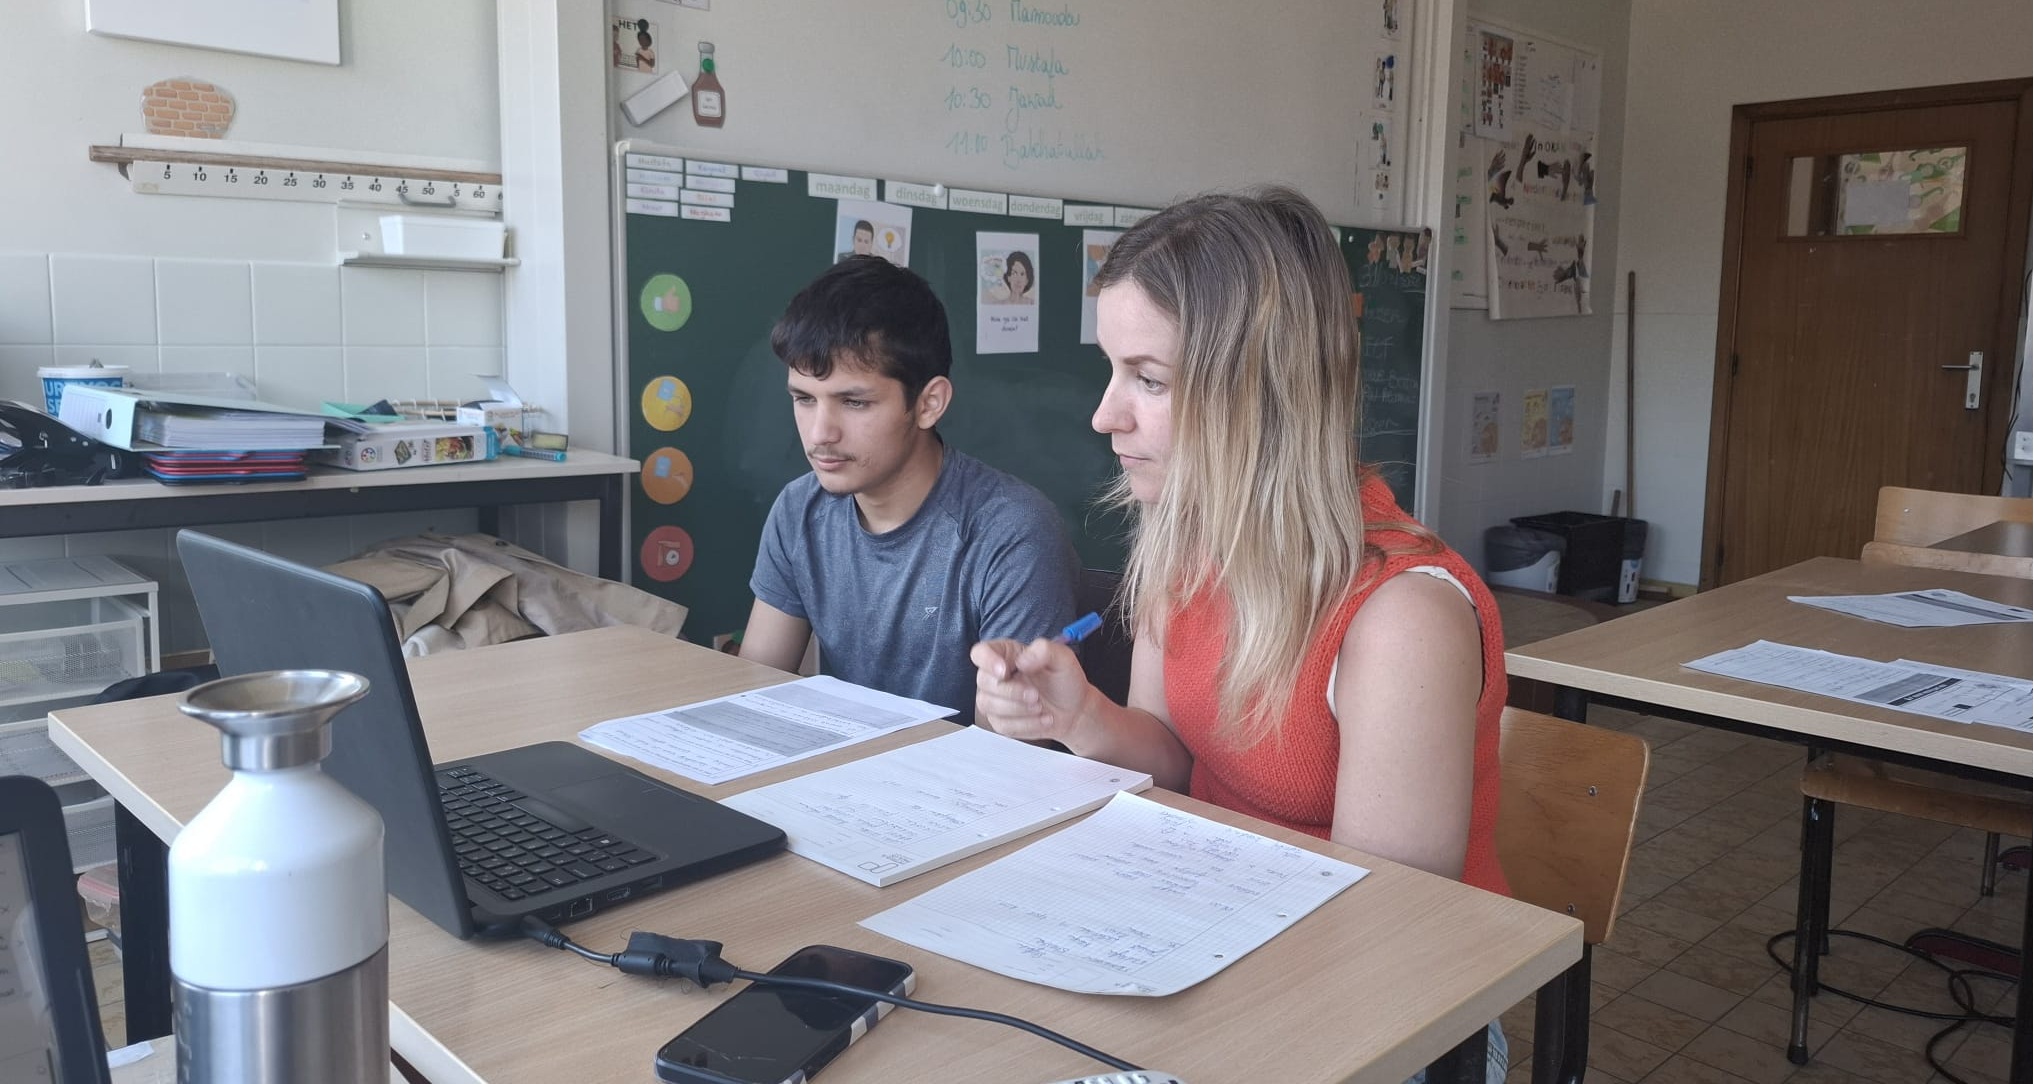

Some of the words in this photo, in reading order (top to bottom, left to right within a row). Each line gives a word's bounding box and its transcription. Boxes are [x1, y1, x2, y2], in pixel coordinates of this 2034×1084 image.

[163, 171, 171, 180] 5
[193, 173, 207, 182] 10
[224, 174, 237, 183] 15
[254, 176, 268, 185] 20
[283, 178, 297, 187] 25
[313, 180, 326, 188] 30
[341, 181, 354, 190] 35
[369, 183, 382, 192] 40
[396, 185, 408, 194] 45
[422, 187, 435, 195] 50
[473, 190, 485, 199] 60
[815, 181, 871, 199] maandag
[896, 187, 937, 207] dinsdag
[952, 194, 1004, 213] woensdag
[1011, 200, 1061, 218] donderdag
[1074, 210, 1104, 225] vrijdag
